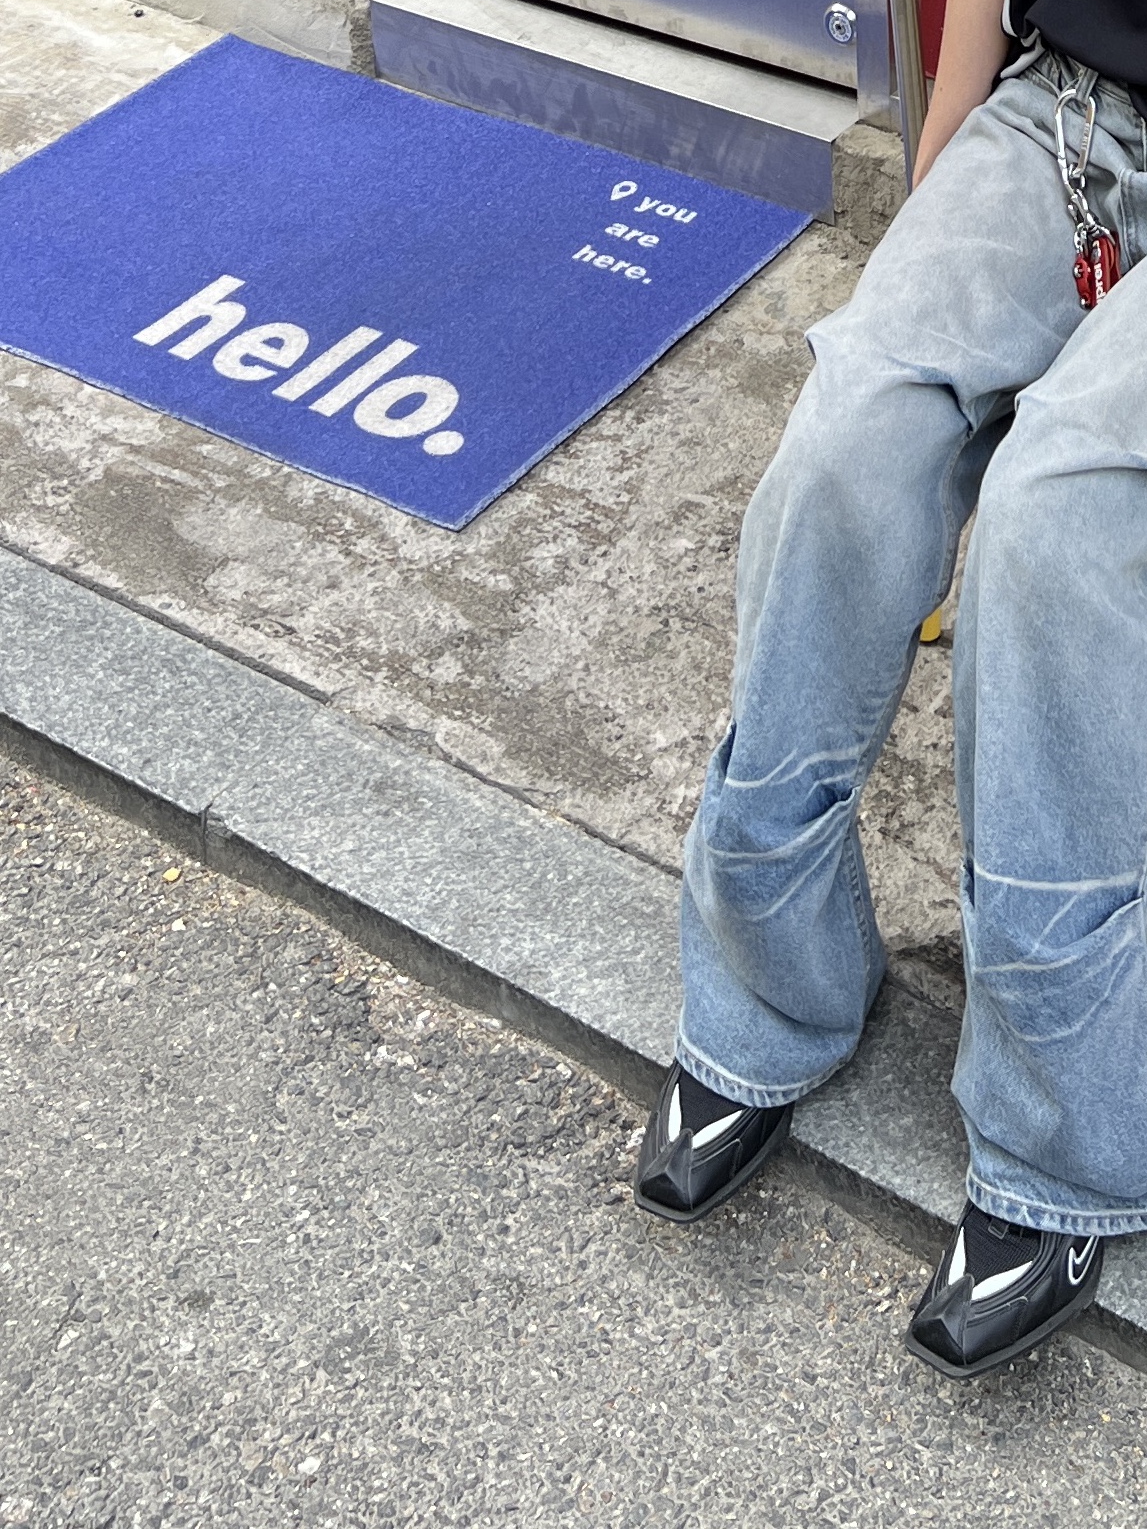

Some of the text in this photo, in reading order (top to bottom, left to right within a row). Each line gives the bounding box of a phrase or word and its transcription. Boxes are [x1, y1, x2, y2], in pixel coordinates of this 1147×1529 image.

[635, 193, 697, 225] you
[605, 219, 660, 249] are
[573, 244, 654, 285] here.
[133, 274, 464, 456] hello.
